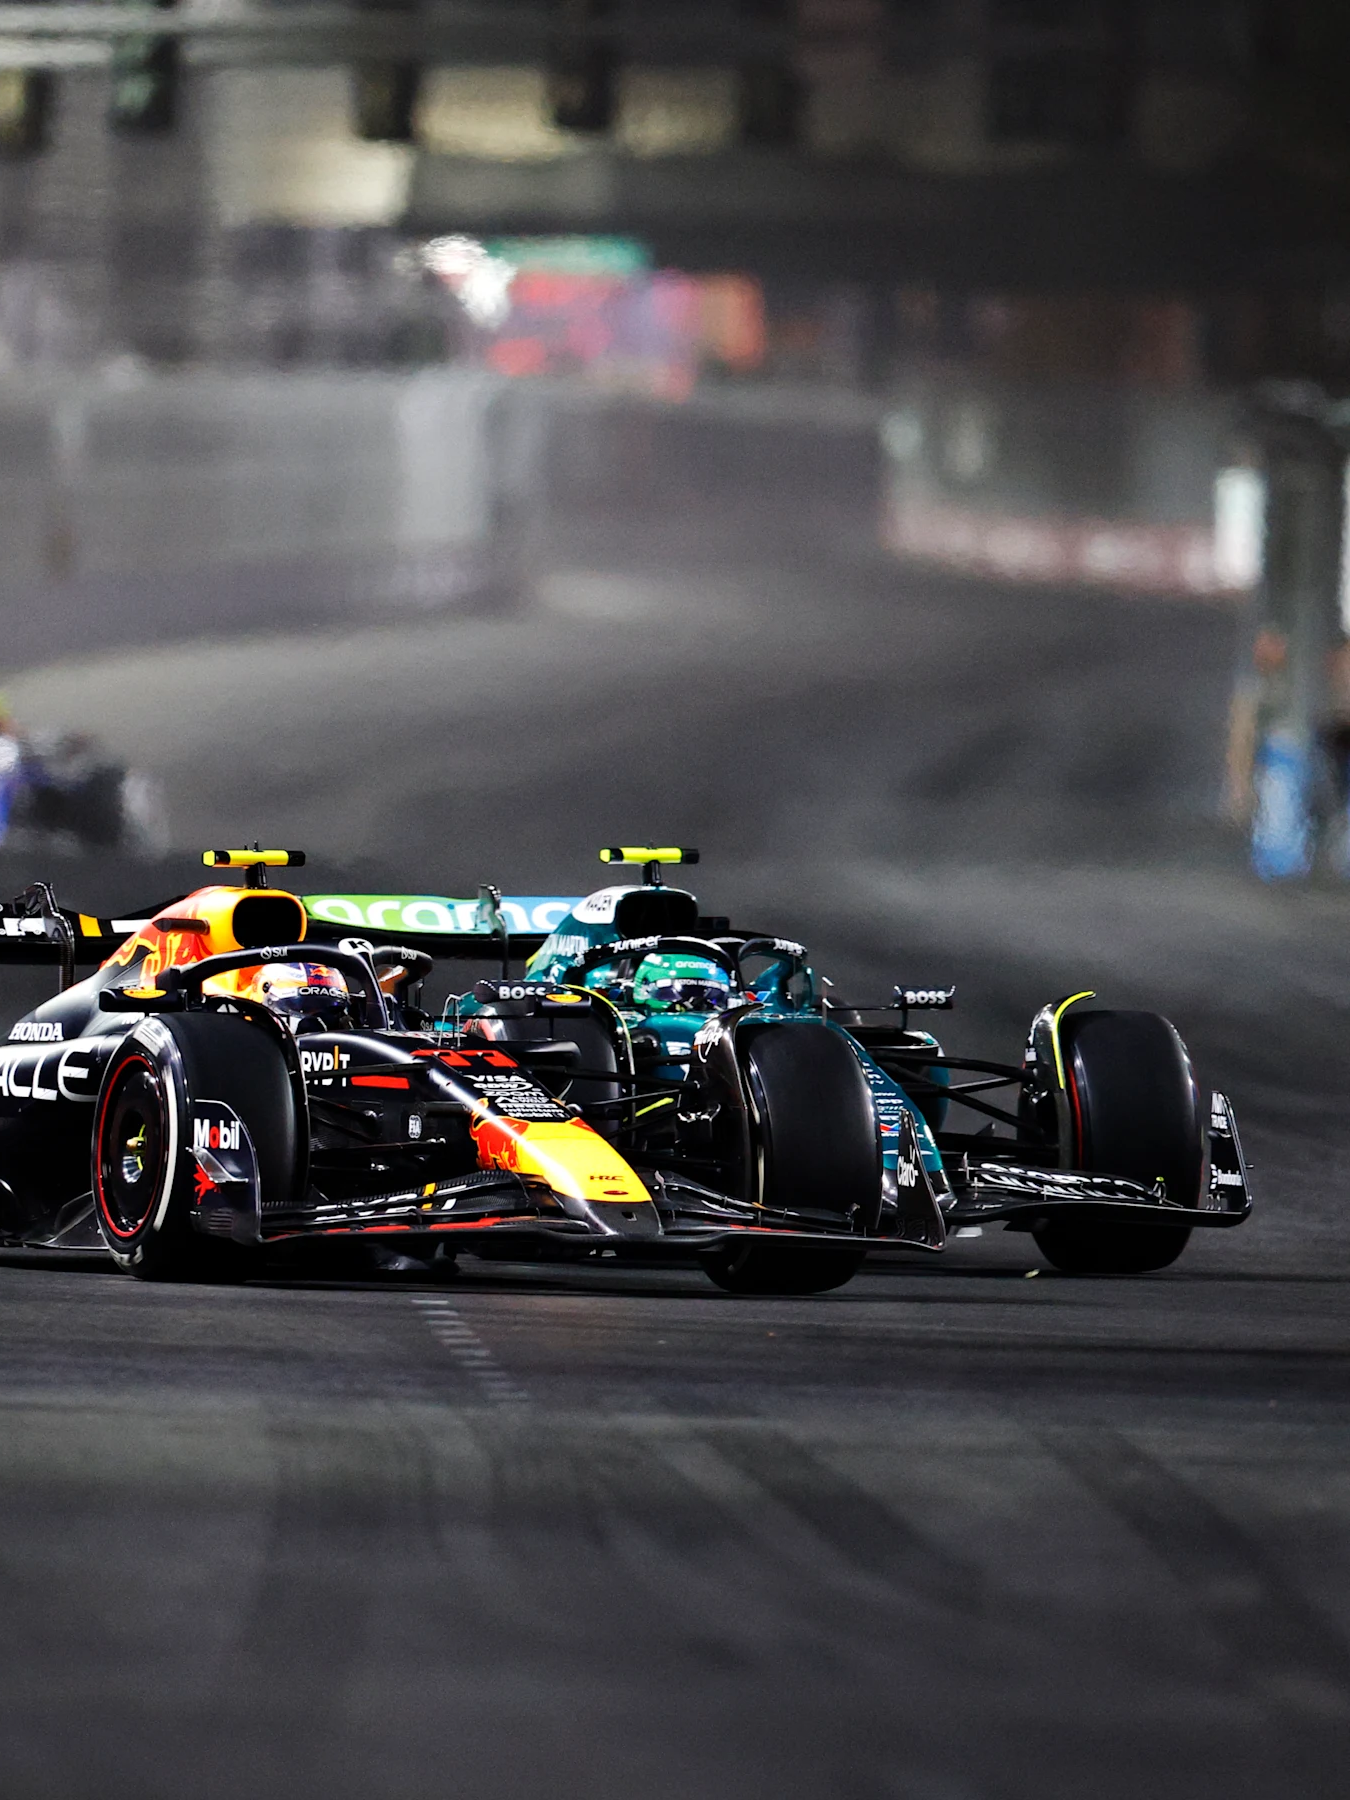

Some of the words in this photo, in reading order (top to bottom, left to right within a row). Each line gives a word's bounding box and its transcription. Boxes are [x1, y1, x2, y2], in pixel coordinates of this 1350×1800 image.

[906, 991, 947, 1005] BOSS
[8, 1022, 64, 1042] HONDA
[463, 1074, 527, 1082] VISA
[193, 1118, 240, 1150] Mobil
